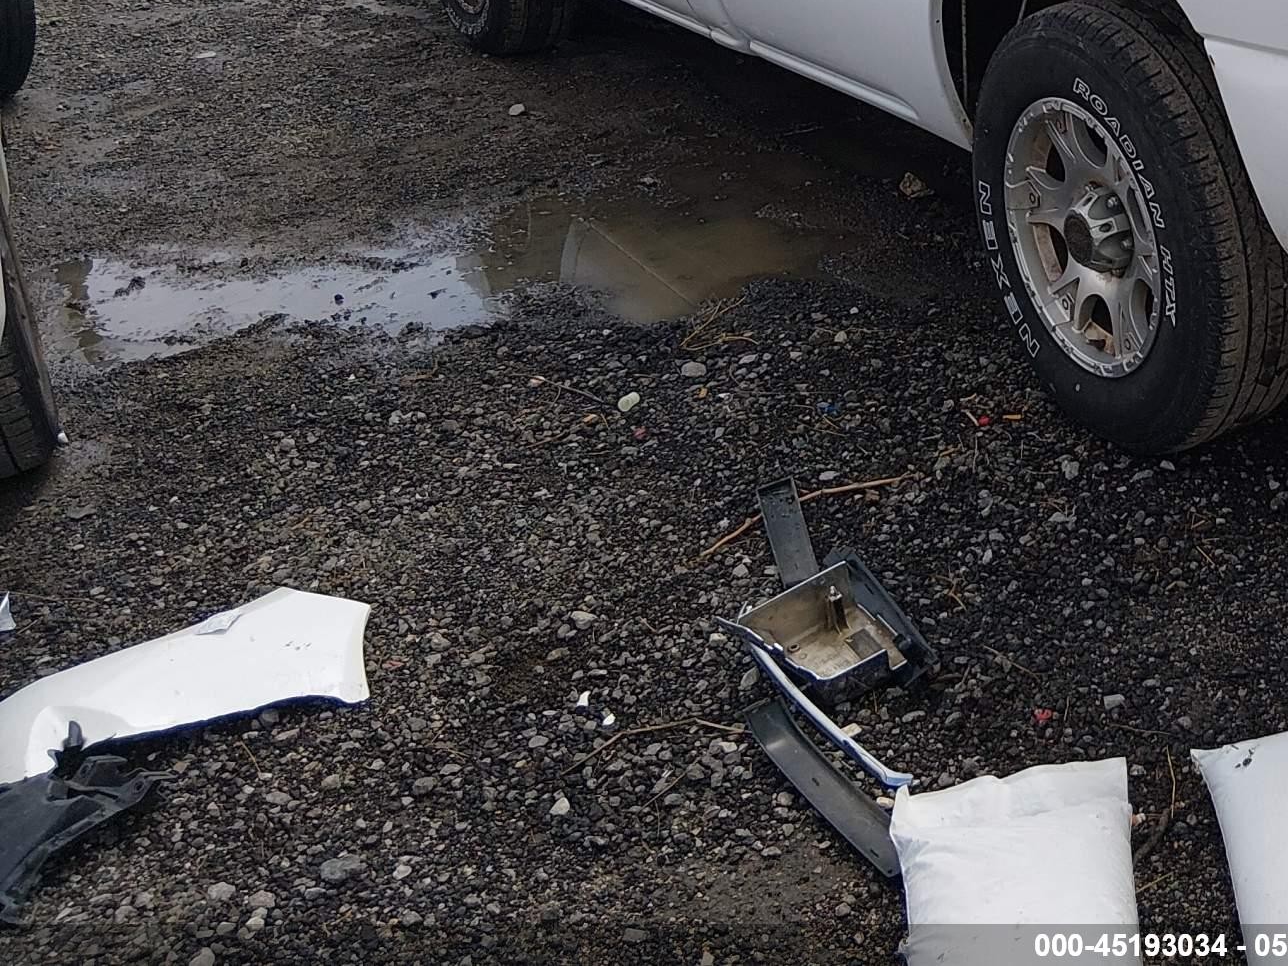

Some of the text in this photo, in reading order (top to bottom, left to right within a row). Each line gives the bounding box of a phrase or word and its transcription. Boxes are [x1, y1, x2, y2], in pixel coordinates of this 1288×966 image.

[979, 180, 1041, 357] NEXEN
[1073, 78, 1177, 328] ROADIAN HTX
